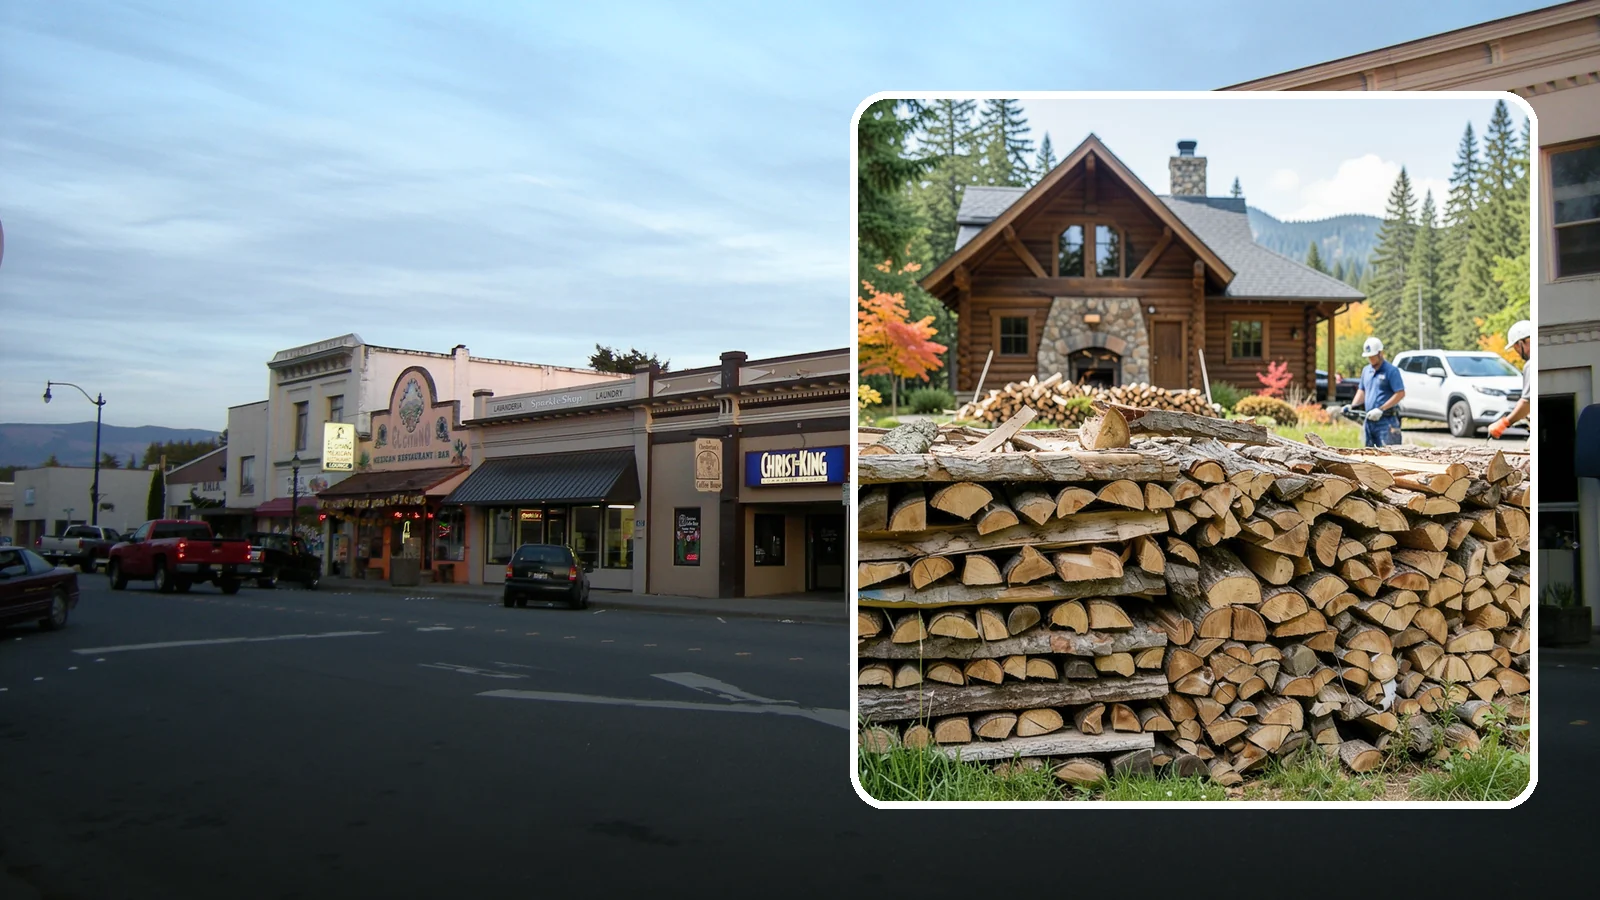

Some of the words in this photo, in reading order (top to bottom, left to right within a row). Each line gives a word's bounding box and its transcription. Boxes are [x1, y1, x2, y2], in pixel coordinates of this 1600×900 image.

[531, 398, 560, 408] Sparkle
[561, 394, 582, 404] Shop
[595, 388, 623, 400] LAUNDRY
[493, 402, 522, 413] LAVANDERIA
[392, 425, 401, 449] EL
[374, 455, 396, 464] MEXICAN
[397, 451, 433, 462] RESTAURANT
[438, 450, 450, 459] BAR
[761, 452, 797, 477] CHRIST
[799, 450, 827, 476] KING
[696, 481, 709, 489] Coffee
[710, 481, 722, 489] House
